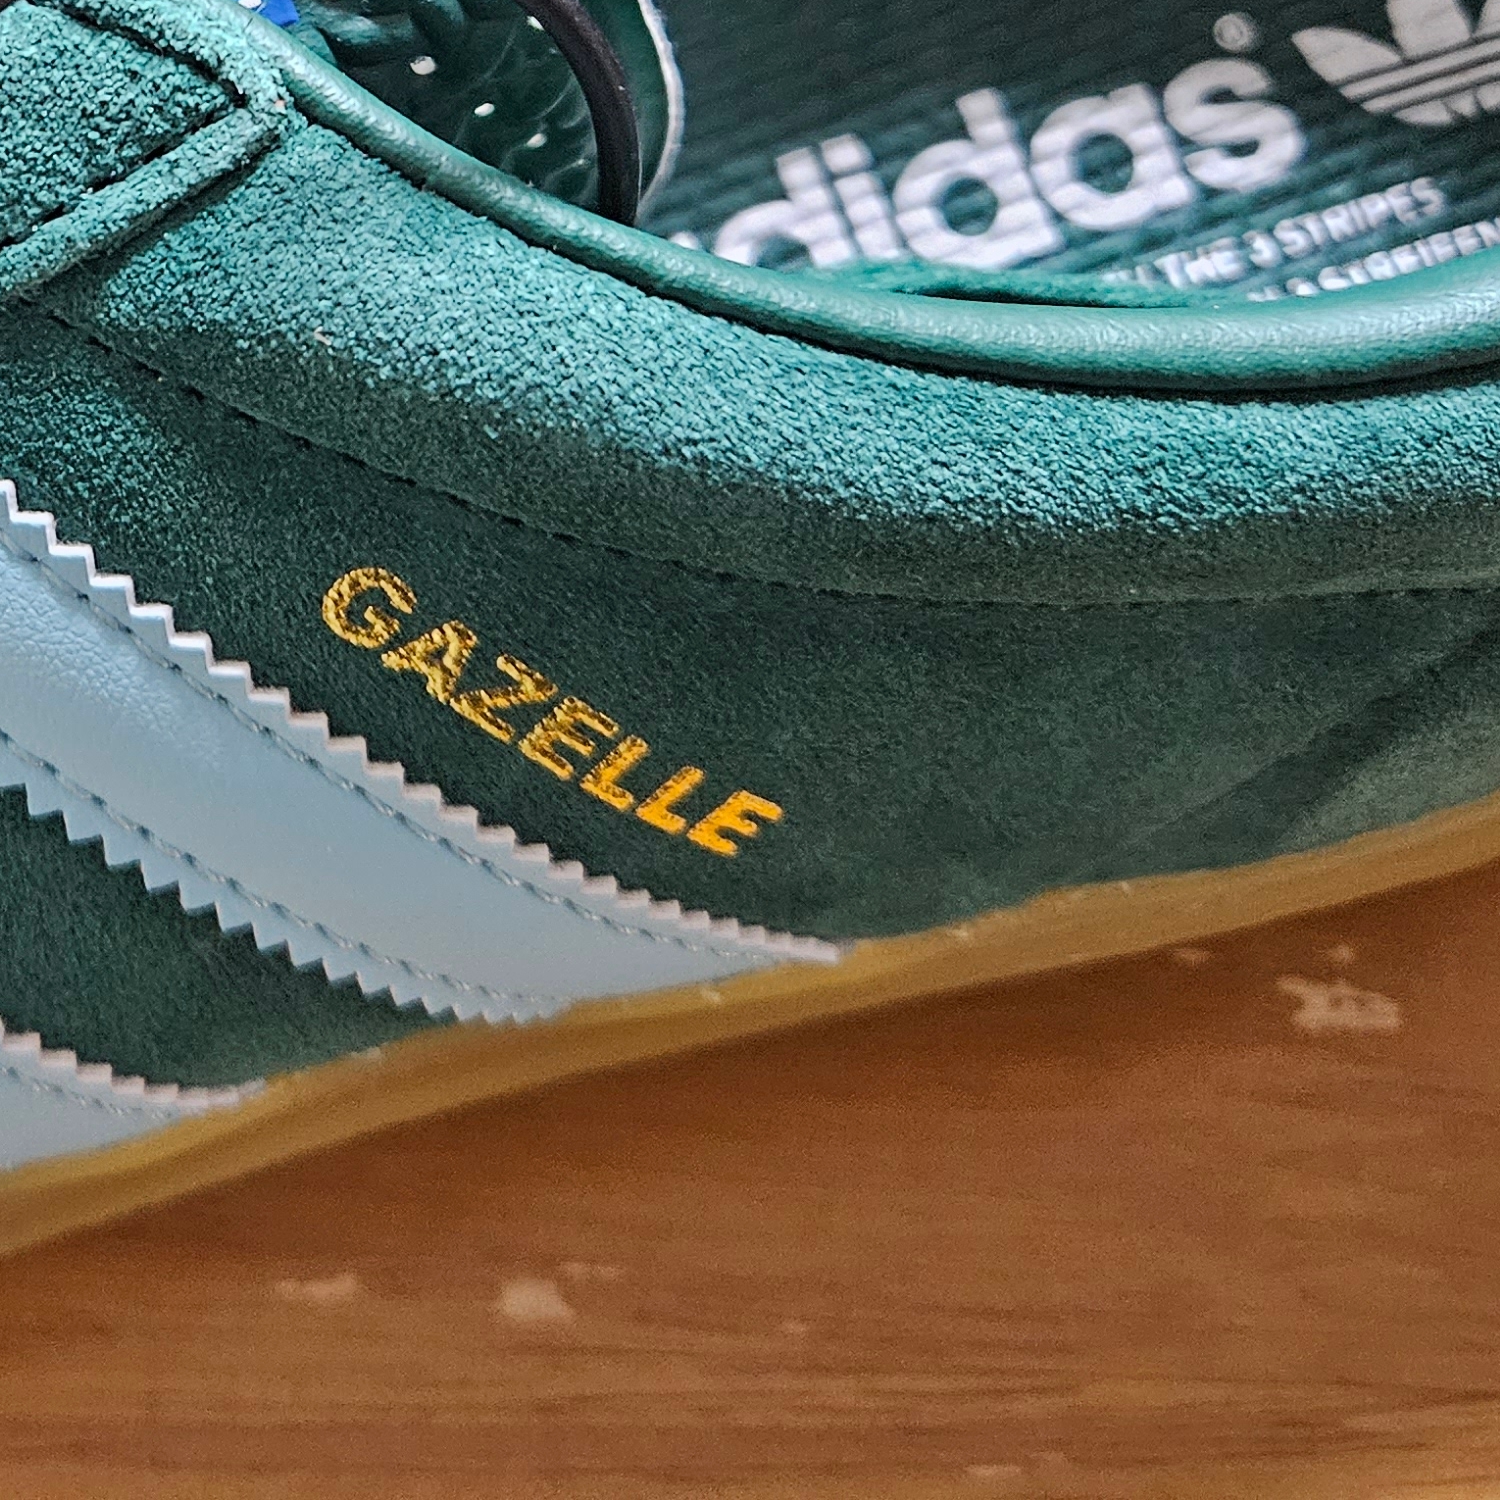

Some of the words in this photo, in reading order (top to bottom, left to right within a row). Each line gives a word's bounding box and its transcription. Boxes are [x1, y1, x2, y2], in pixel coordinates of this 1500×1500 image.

[668, 57, 1304, 271] didas
[1242, 229, 1284, 269] 3
[1273, 176, 1445, 259] STRIPES
[322, 565, 784, 858] GAZELLE
